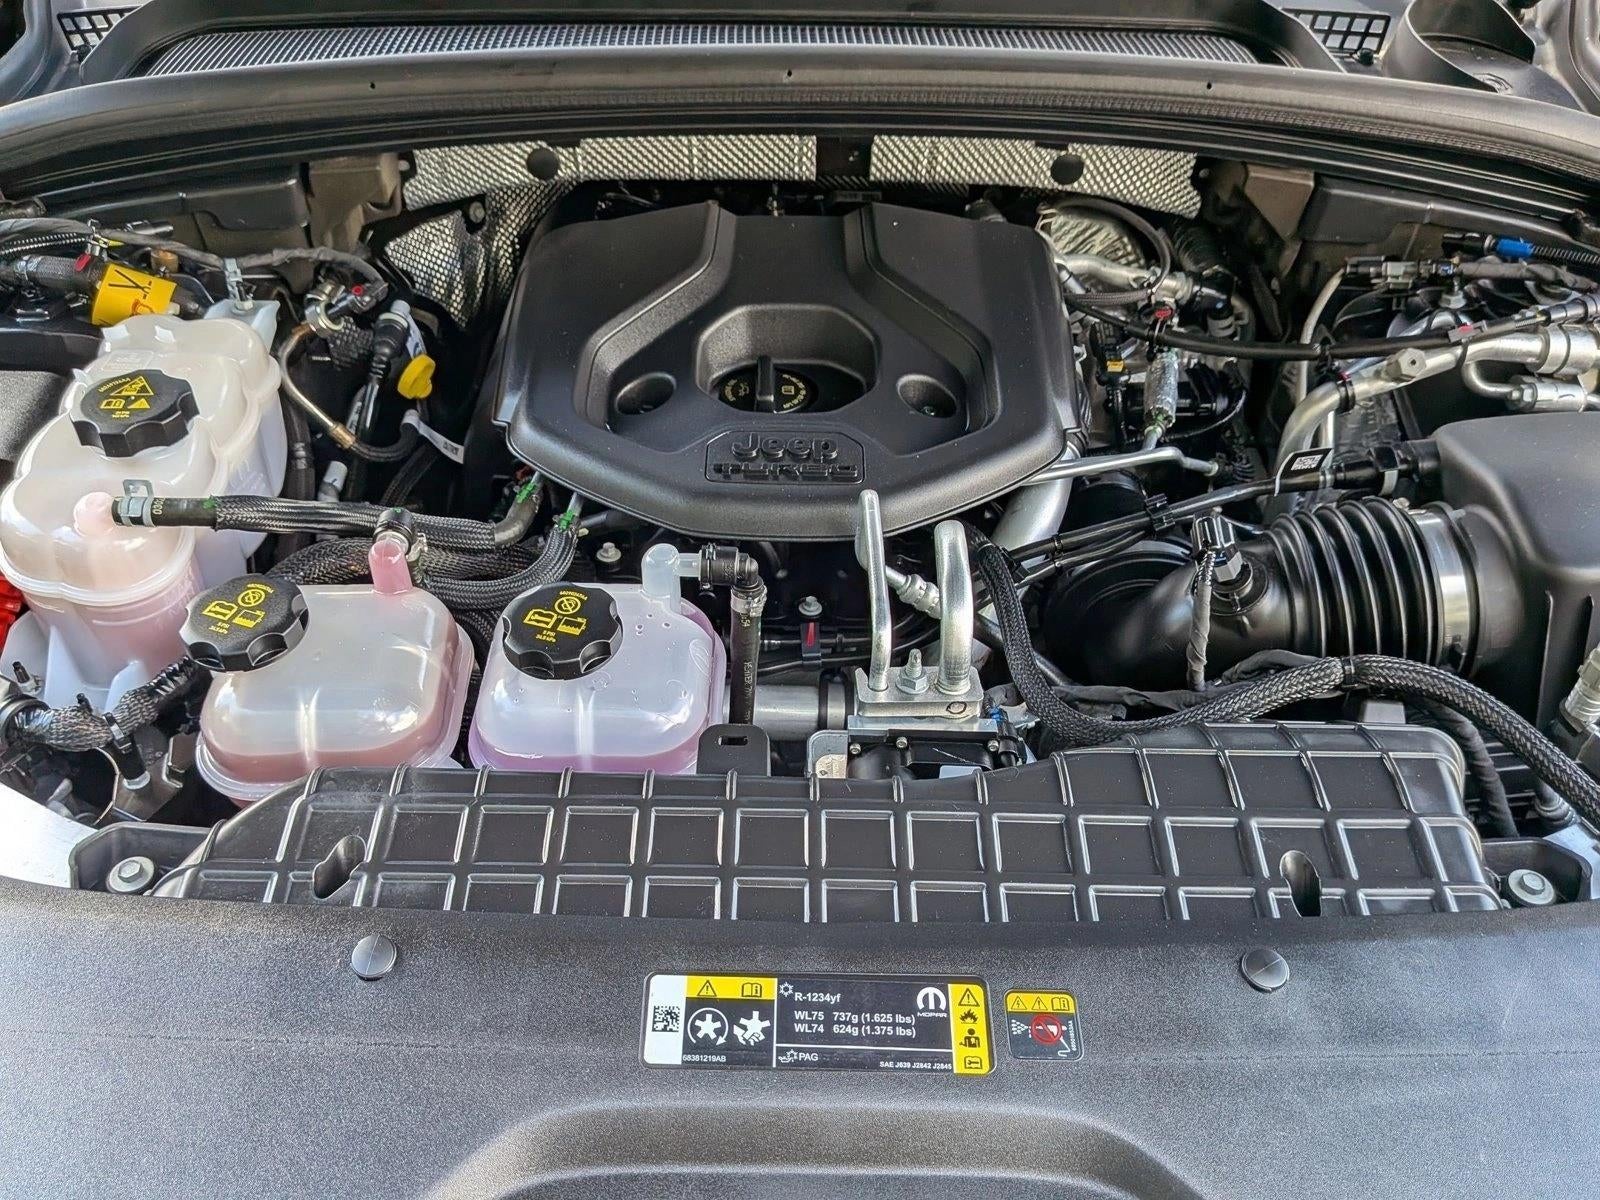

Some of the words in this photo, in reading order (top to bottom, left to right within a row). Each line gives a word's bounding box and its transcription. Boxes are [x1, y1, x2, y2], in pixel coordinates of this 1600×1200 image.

[732, 432, 838, 463] Jeep
[794, 992, 841, 1004] R-1234yf
[794, 1010, 825, 1021] WL75
[833, 1012, 859, 1024] 737g
[861, 1012, 893, 1025] (1.625
[895, 1013, 916, 1026] lbs)
[794, 1023, 825, 1034] WL74
[833, 1025, 859, 1037] 624g
[861, 1025, 894, 1036] (1.375
[895, 1026, 917, 1038] lbs)
[682, 1054, 727, 1063] 68381219AB
[799, 1053, 819, 1062] PAG
[895, 1061, 911, 1069] J639
